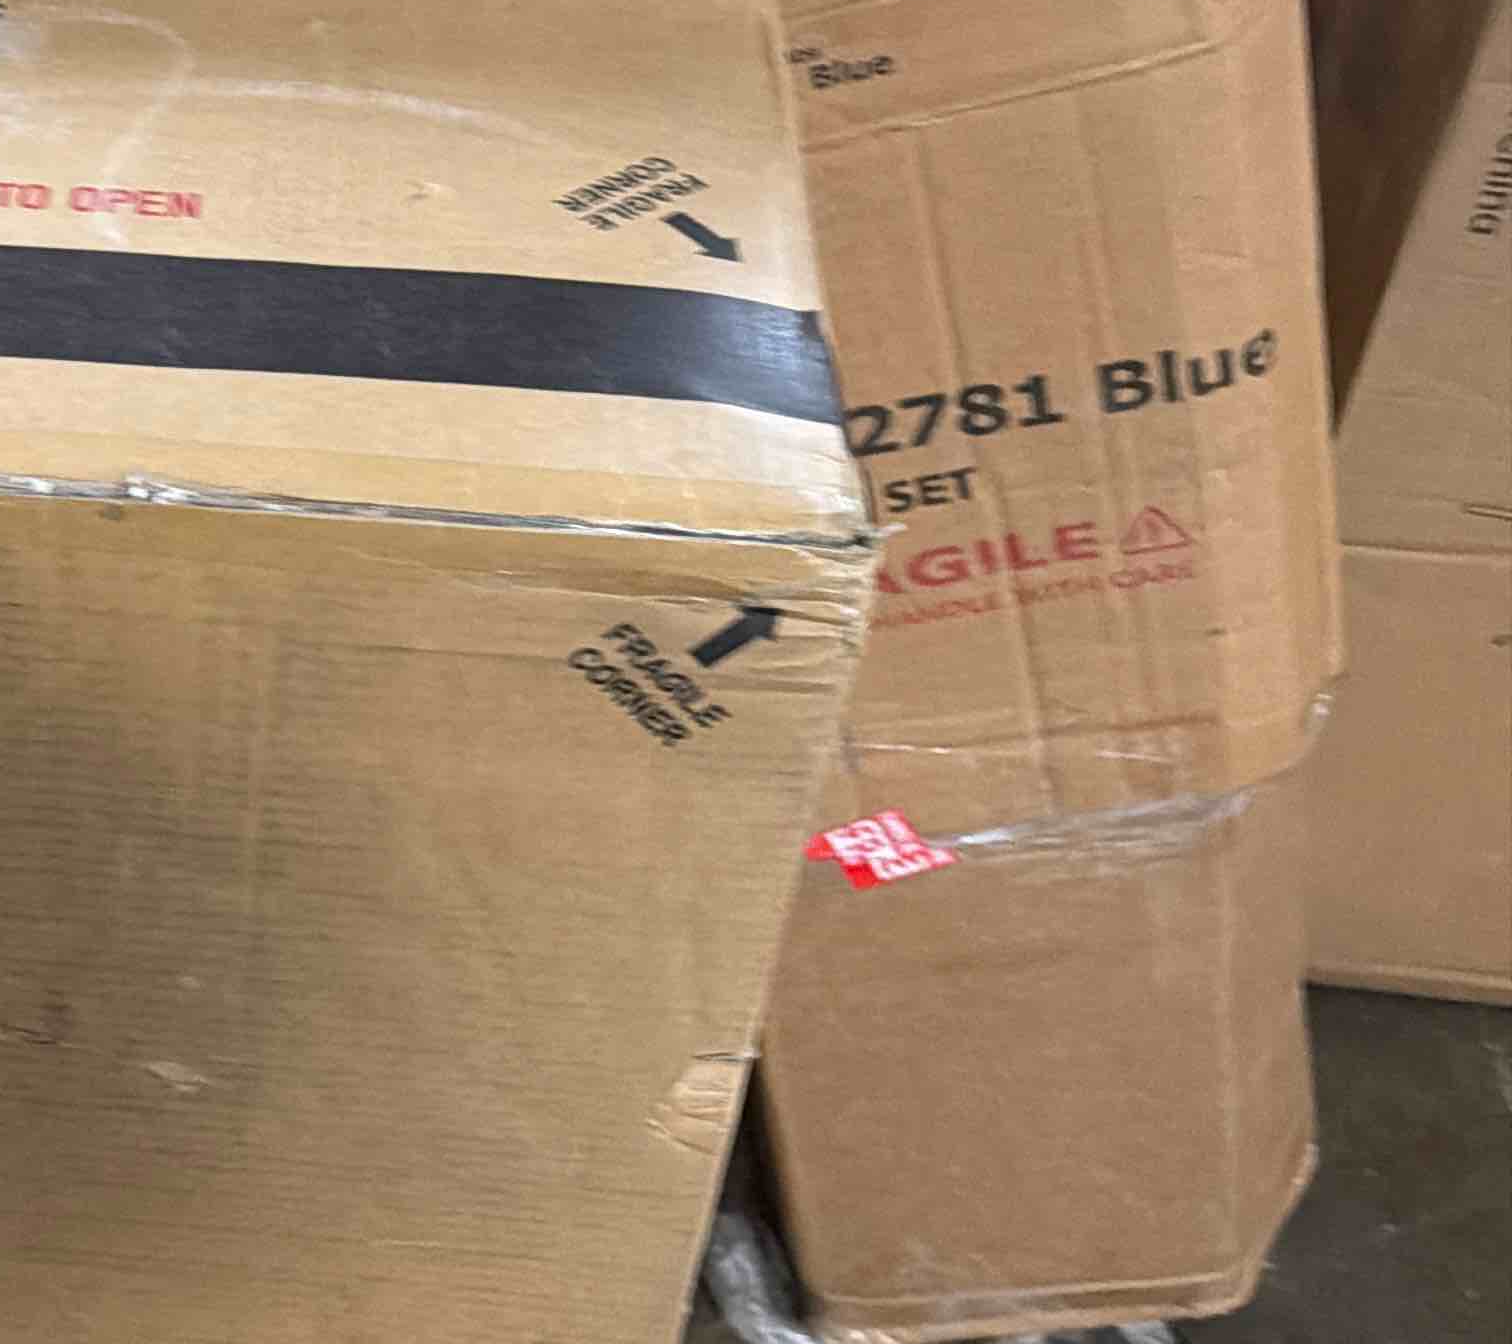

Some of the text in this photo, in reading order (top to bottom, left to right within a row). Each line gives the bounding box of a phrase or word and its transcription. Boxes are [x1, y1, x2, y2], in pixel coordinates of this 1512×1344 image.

[68, 186, 204, 220] OPEN
[845, 328, 1280, 457] 2781 Blue
[872, 522, 1104, 595] GILE
